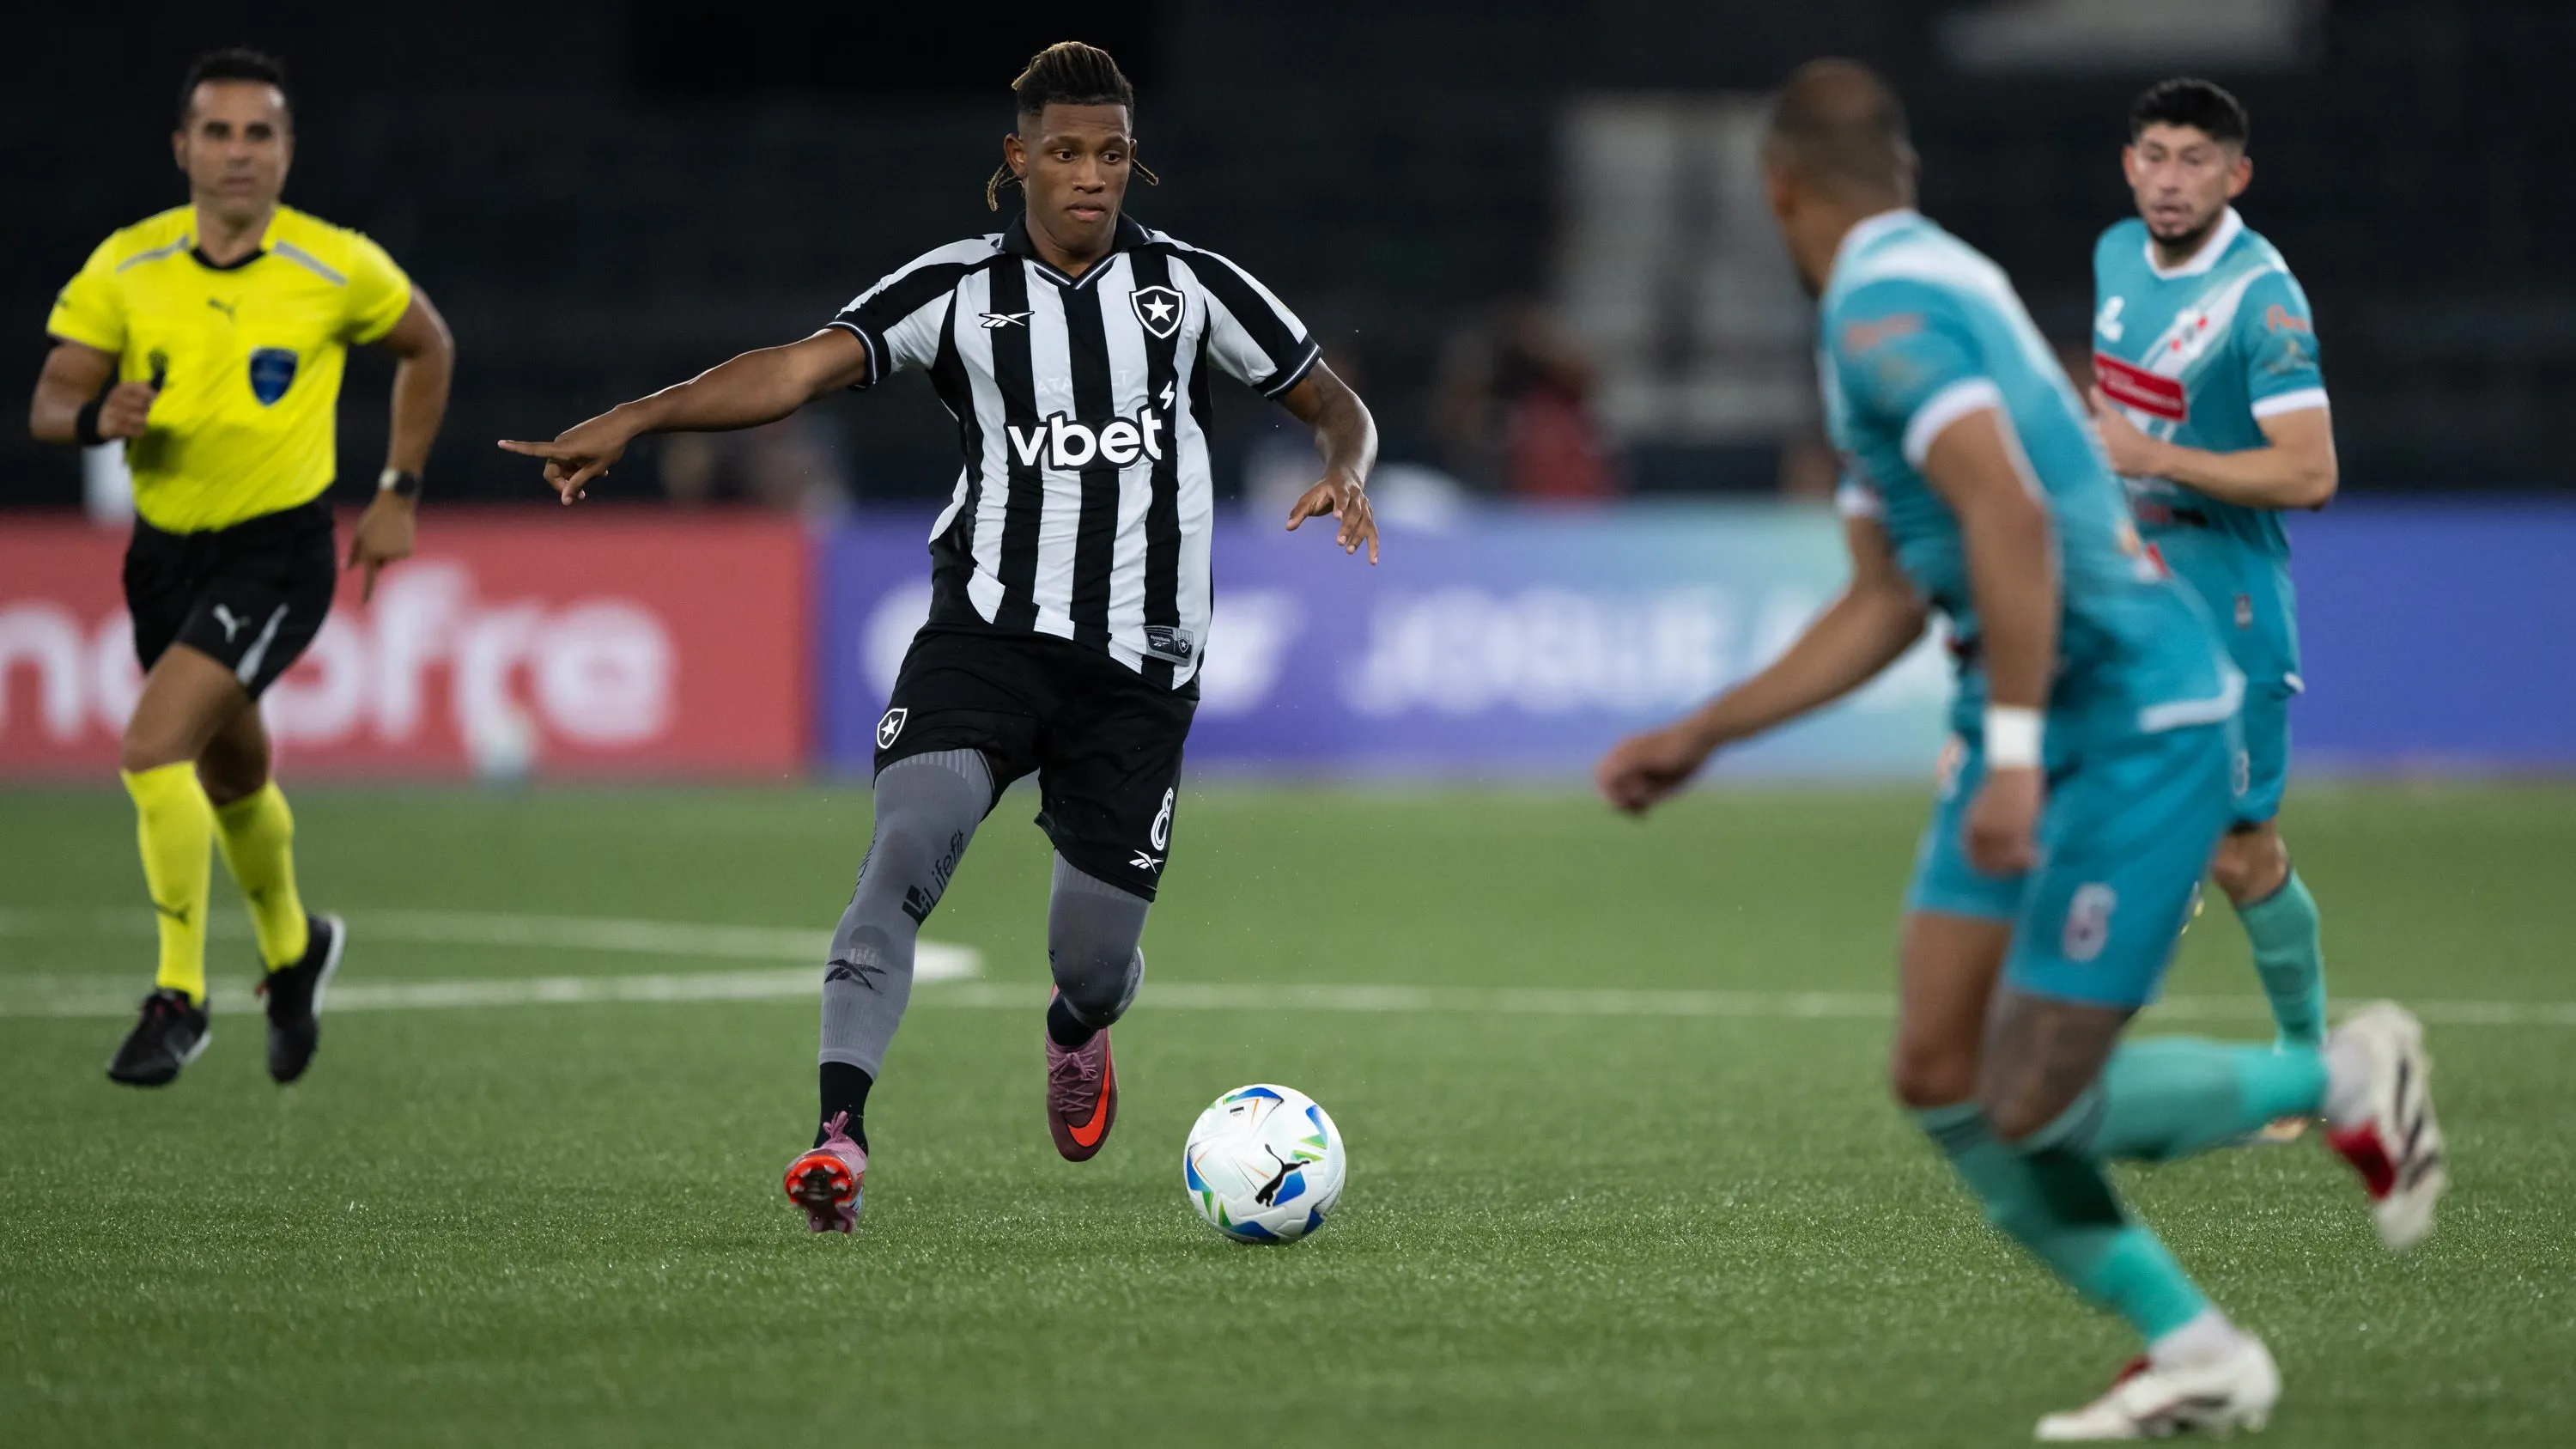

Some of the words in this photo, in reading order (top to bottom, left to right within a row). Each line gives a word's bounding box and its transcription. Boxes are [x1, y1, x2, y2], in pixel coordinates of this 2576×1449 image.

[1006, 407, 1163, 467] vbet
[1151, 787, 1174, 851] 8
[2063, 882, 2118, 961] 6
